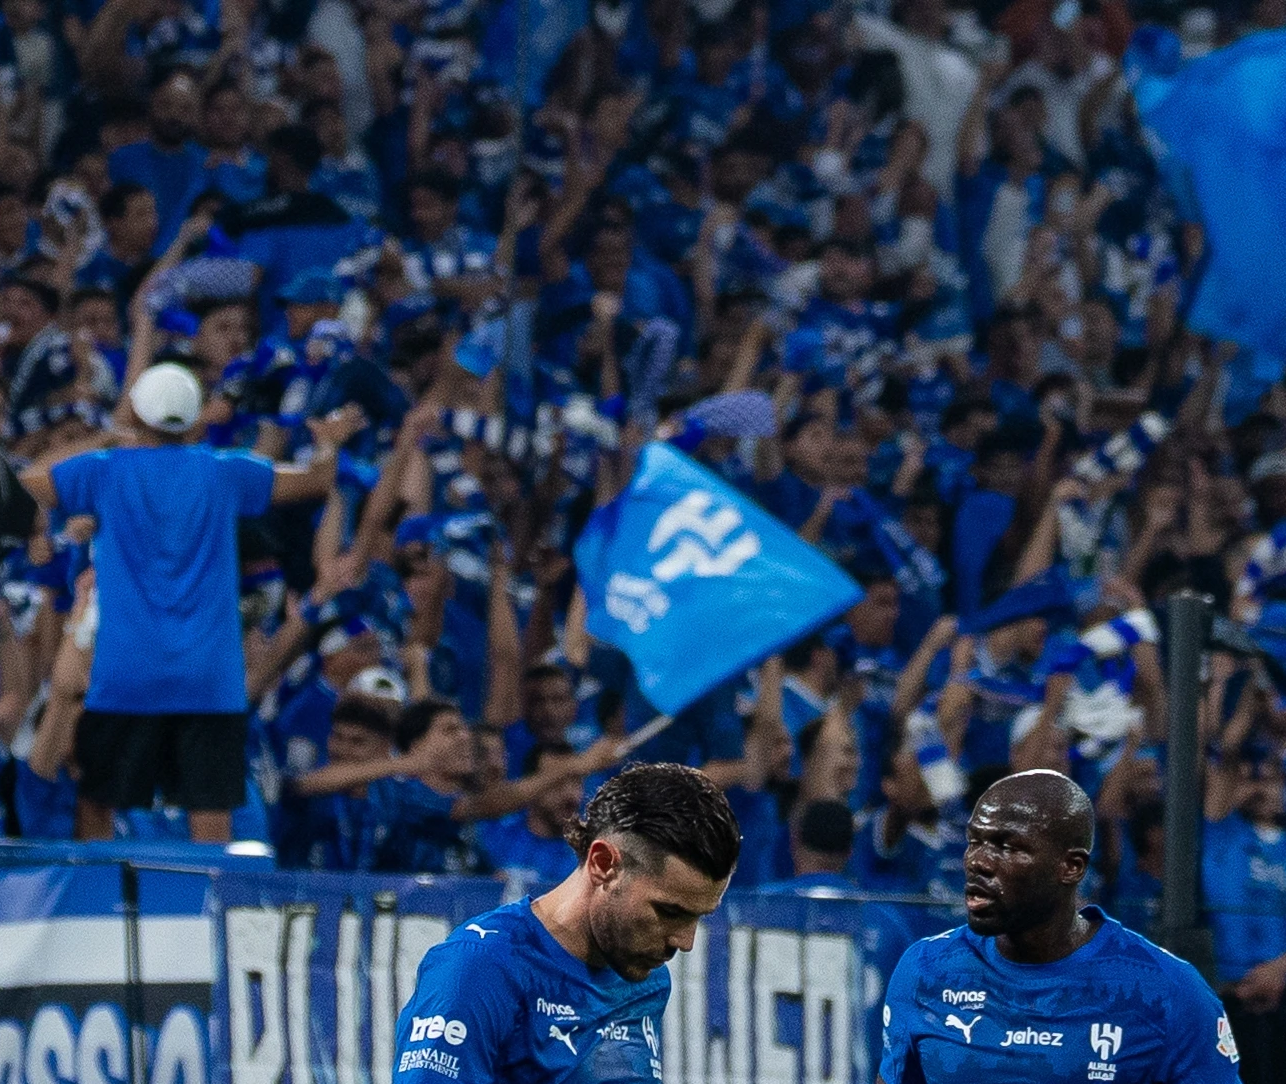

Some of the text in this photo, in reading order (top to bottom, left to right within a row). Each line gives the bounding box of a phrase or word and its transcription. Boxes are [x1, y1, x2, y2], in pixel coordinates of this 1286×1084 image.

[536, 996, 575, 1016] flynas
[942, 989, 986, 1004] flynas
[409, 1014, 467, 1046] tree
[1000, 1027, 1064, 1047] jahez
